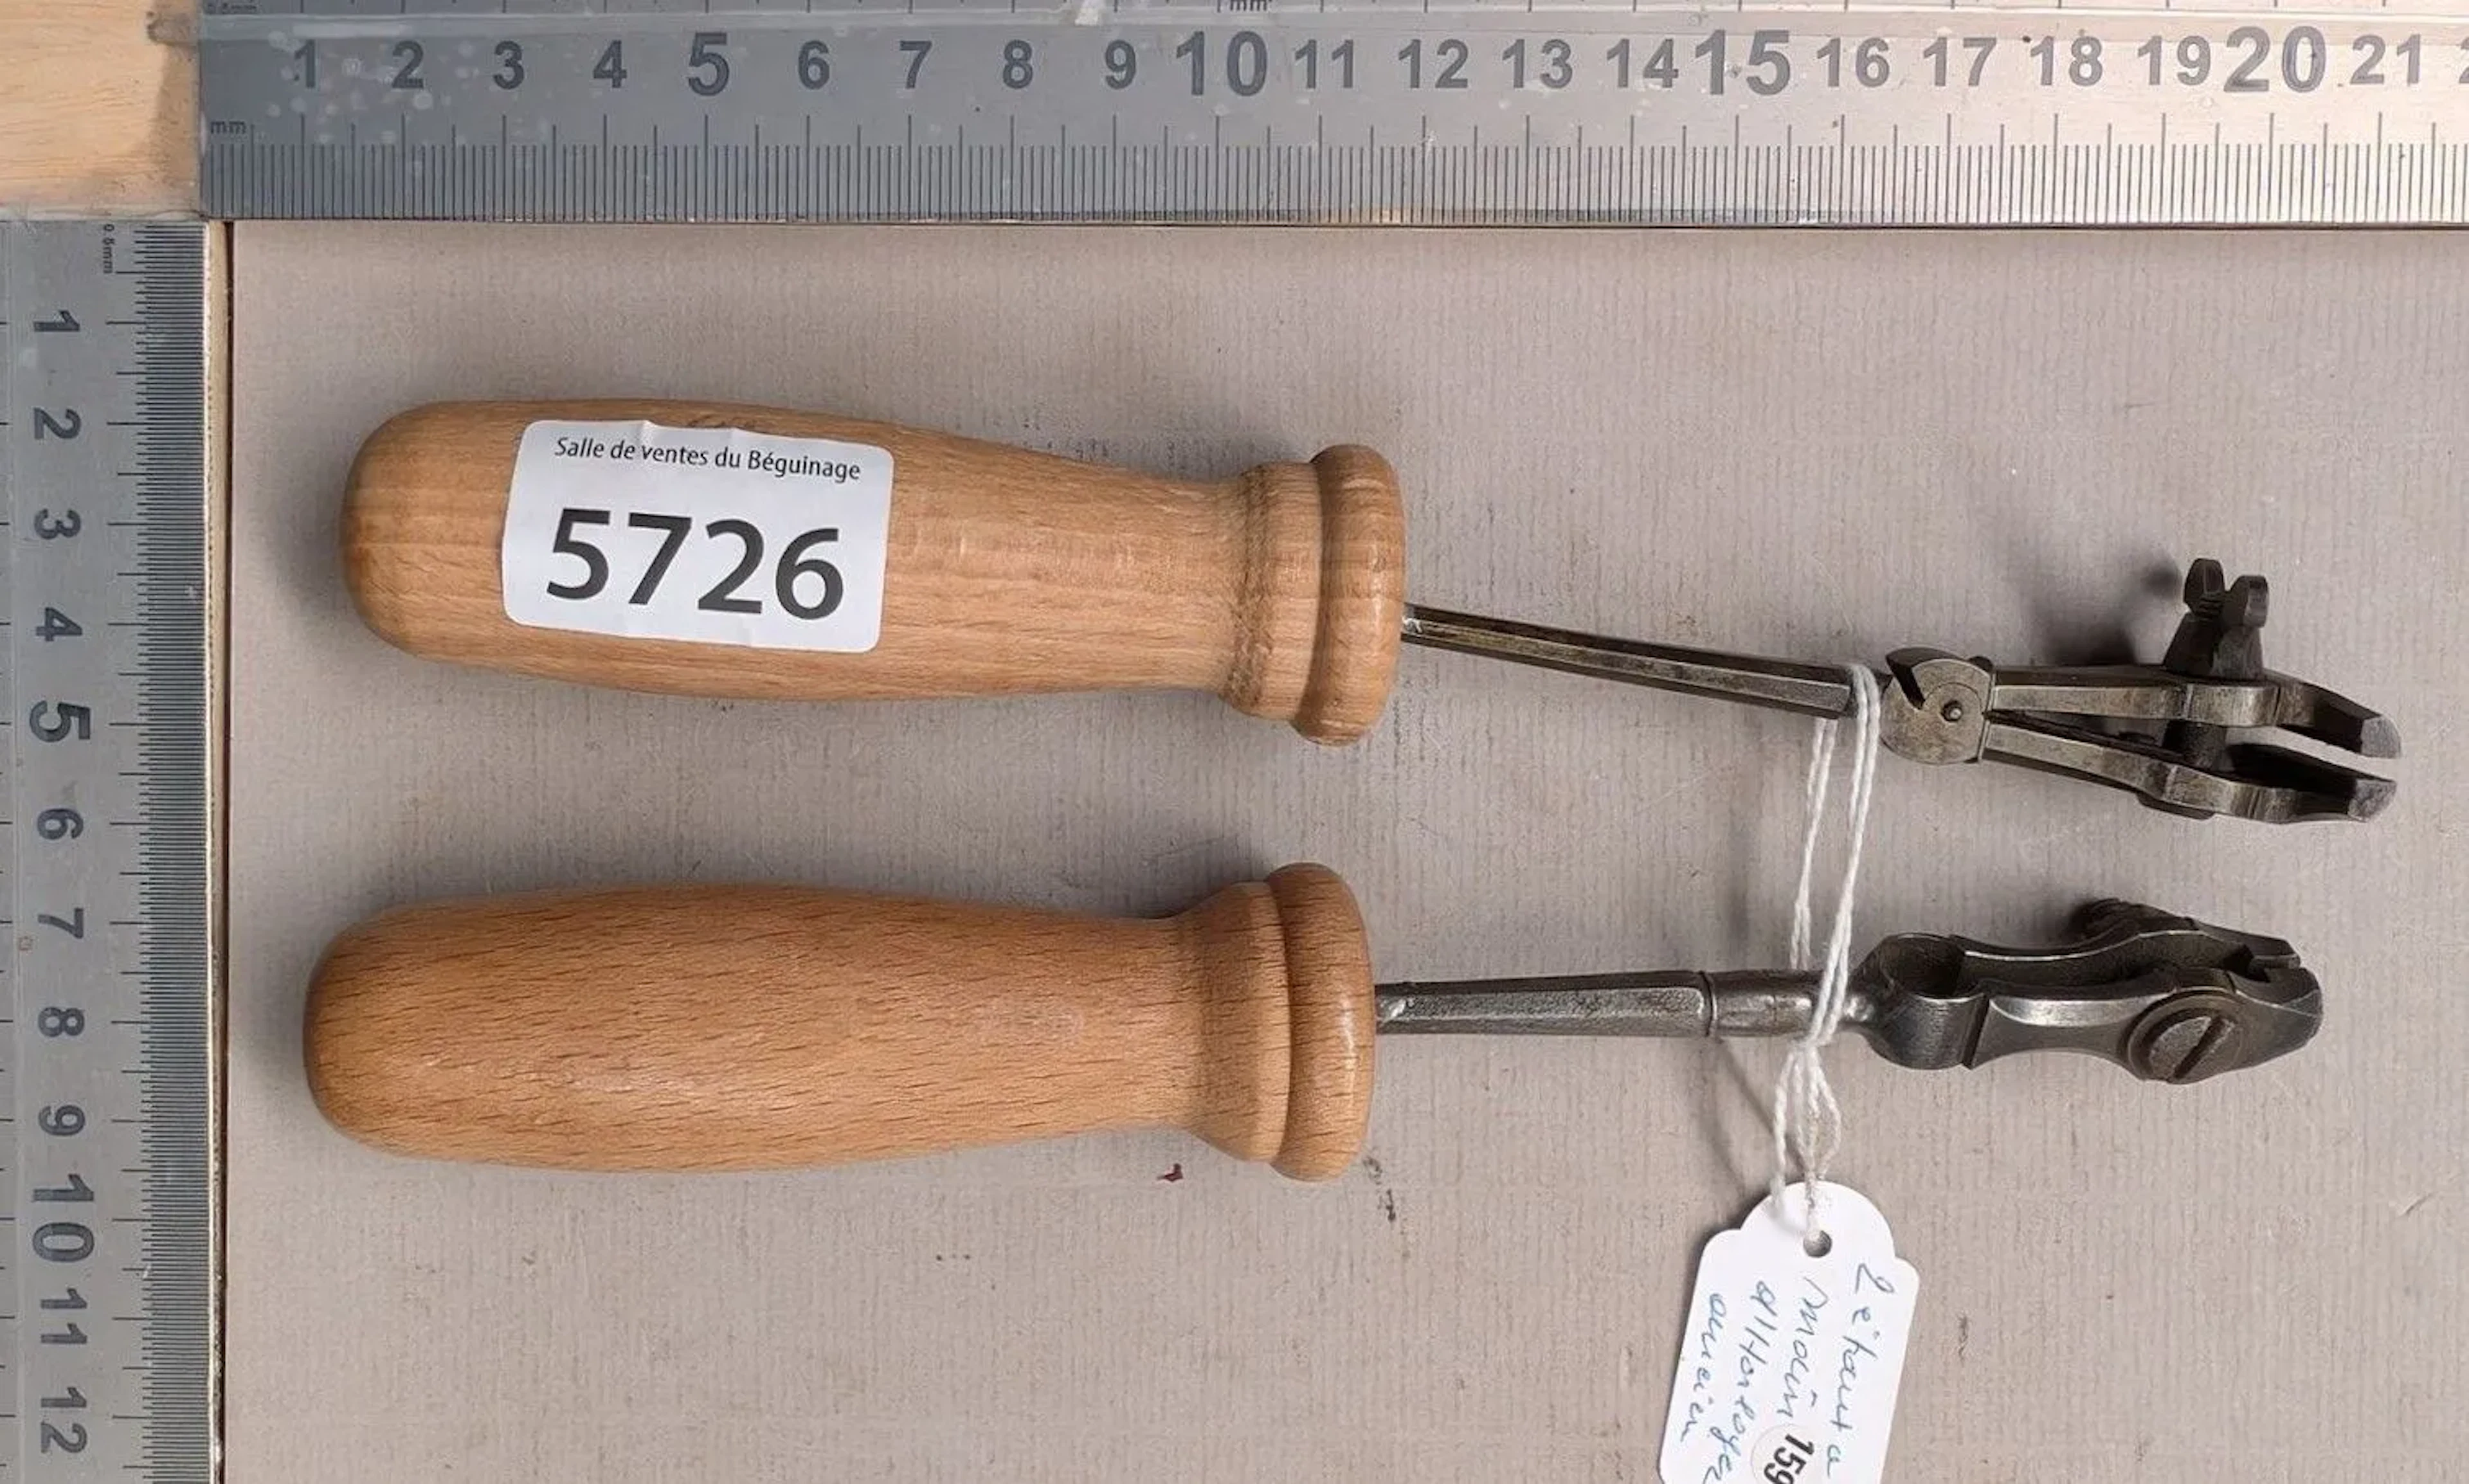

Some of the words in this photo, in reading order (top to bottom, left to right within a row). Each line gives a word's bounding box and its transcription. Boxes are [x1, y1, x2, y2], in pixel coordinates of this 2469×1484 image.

[293, 39, 316, 88] 1
[392, 40, 424, 88] 2
[493, 40, 525, 89] 3
[593, 40, 627, 88] 4
[688, 32, 729, 95] 5
[798, 40, 830, 89] 6
[901, 41, 932, 89] 7
[1002, 40, 1033, 89] 8
[1105, 40, 1136, 89] 9
[1176, 31, 1268, 96] 10
[1294, 39, 1354, 89] 11
[1398, 39, 1469, 88] 12
[1503, 39, 1573, 88] 13
[1606, 39, 1679, 88] 14
[1695, 30, 1791, 96] 15
[1816, 38, 1890, 87] 16
[1923, 37, 1997, 87] 17
[2030, 35, 2103, 86] 18
[2137, 35, 2211, 86] 19
[2224, 26, 2326, 93] 20
[2349, 34, 2421, 86] 21
[210, 121, 246, 134] mm
[33, 309, 80, 332] 1
[33, 408, 82, 440] 2
[555, 437, 604, 460] Salle
[610, 439, 635, 460] de
[641, 445, 708, 466] ventes
[715, 450, 741, 469] du
[748, 451, 861, 484] Béguinage
[34, 509, 81, 539] 3
[546, 507, 844, 620] 5726
[35, 606, 82, 642] 4
[30, 700, 91, 743] 5
[37, 808, 84, 840] 6
[37, 908, 84, 939] 7
[38, 1007, 85, 1038] 8
[39, 1105, 86, 1136] 9
[32, 1173, 95, 1263] 10
[41, 1288, 87, 1344] 11
[41, 1386, 87, 1454] 12
